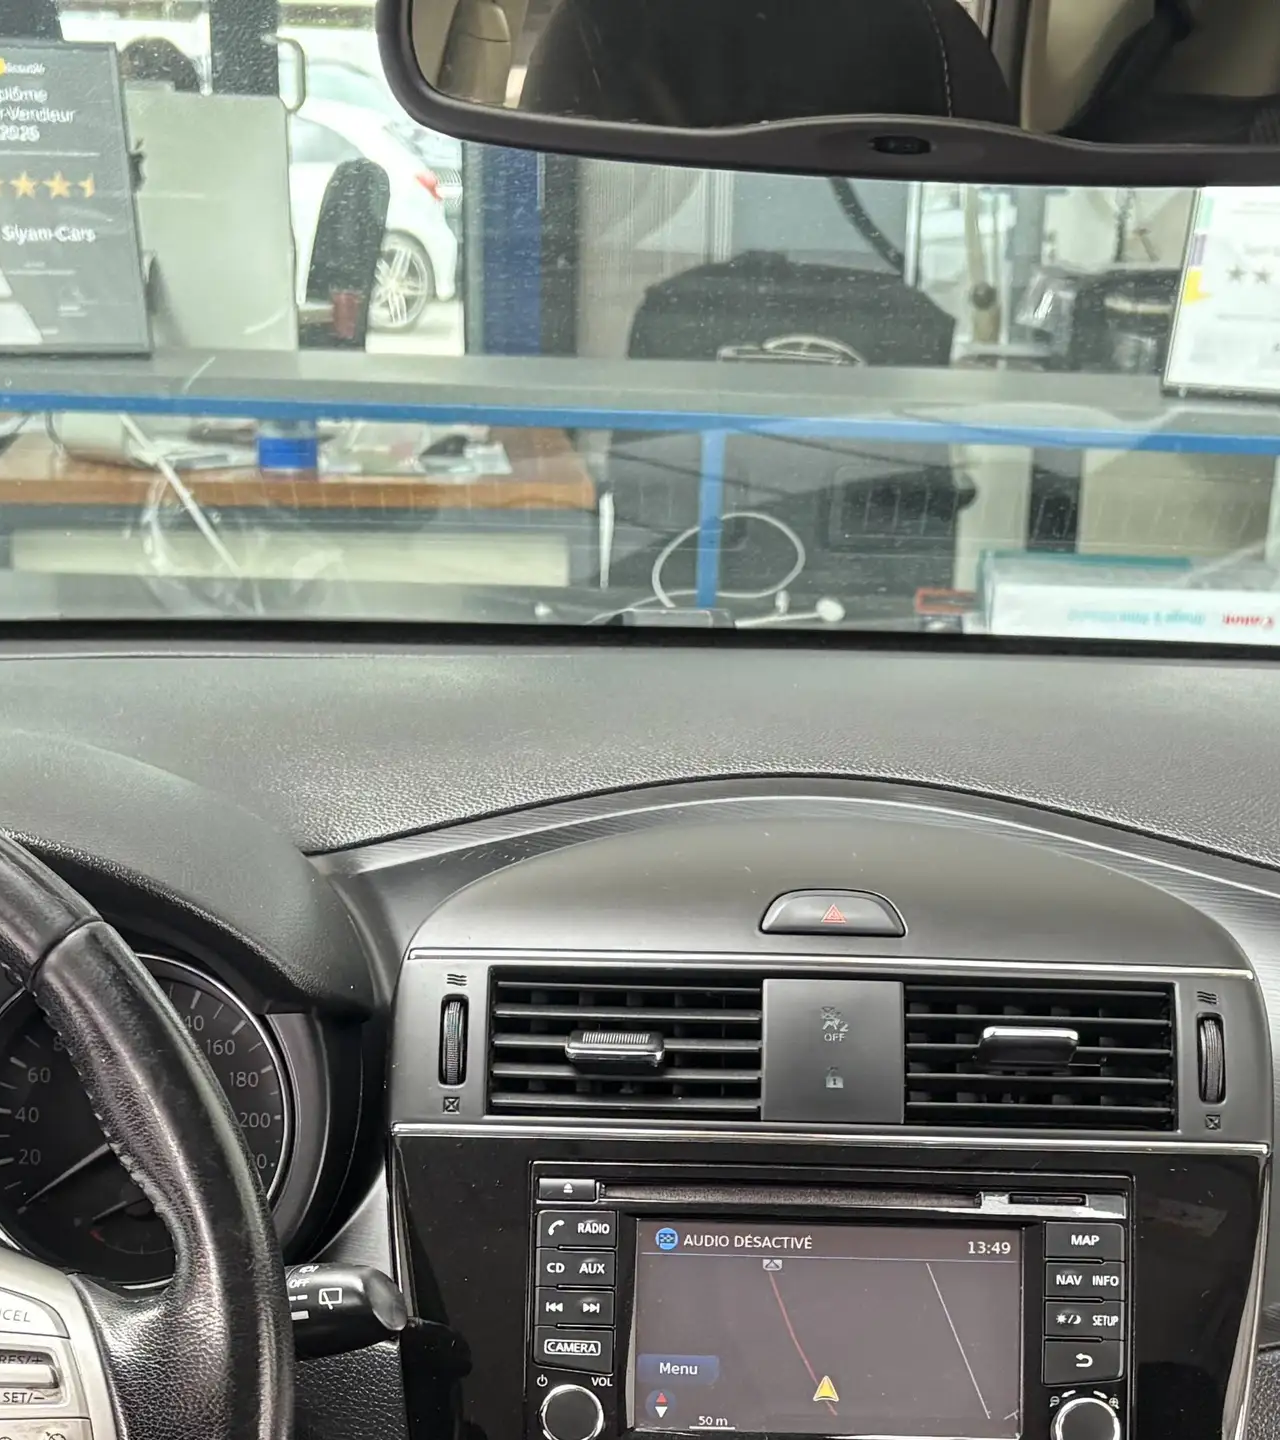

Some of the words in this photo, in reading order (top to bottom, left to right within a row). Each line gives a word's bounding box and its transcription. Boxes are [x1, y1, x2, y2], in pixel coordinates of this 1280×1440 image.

[206, 1039, 235, 1055] 160
[27, 1068, 51, 1083] 60
[229, 1071, 259, 1087] 180
[14, 1108, 39, 1123] 40
[239, 1112, 271, 1128] 200
[18, 1149, 42, 1165] 20
[577, 1222, 610, 1235] RADIO
[683, 1234, 730, 1247] AUDIO
[734, 1234, 813, 1249] DÉSACTIVÉ
[1070, 1234, 1100, 1246] MAP
[967, 1241, 1011, 1254] 13:49
[546, 1262, 565, 1274] CD
[578, 1263, 606, 1274] AUX
[1055, 1274, 1082, 1286] NAV
[1092, 1275, 1119, 1287] INFO
[1092, 1315, 1119, 1326] SETUP
[546, 1341, 598, 1353] CAMERA
[659, 1362, 698, 1375] Menu
[591, 1376, 613, 1387] VOL
[698, 1415, 713, 1426] 50
[715, 1417, 728, 1426] m
